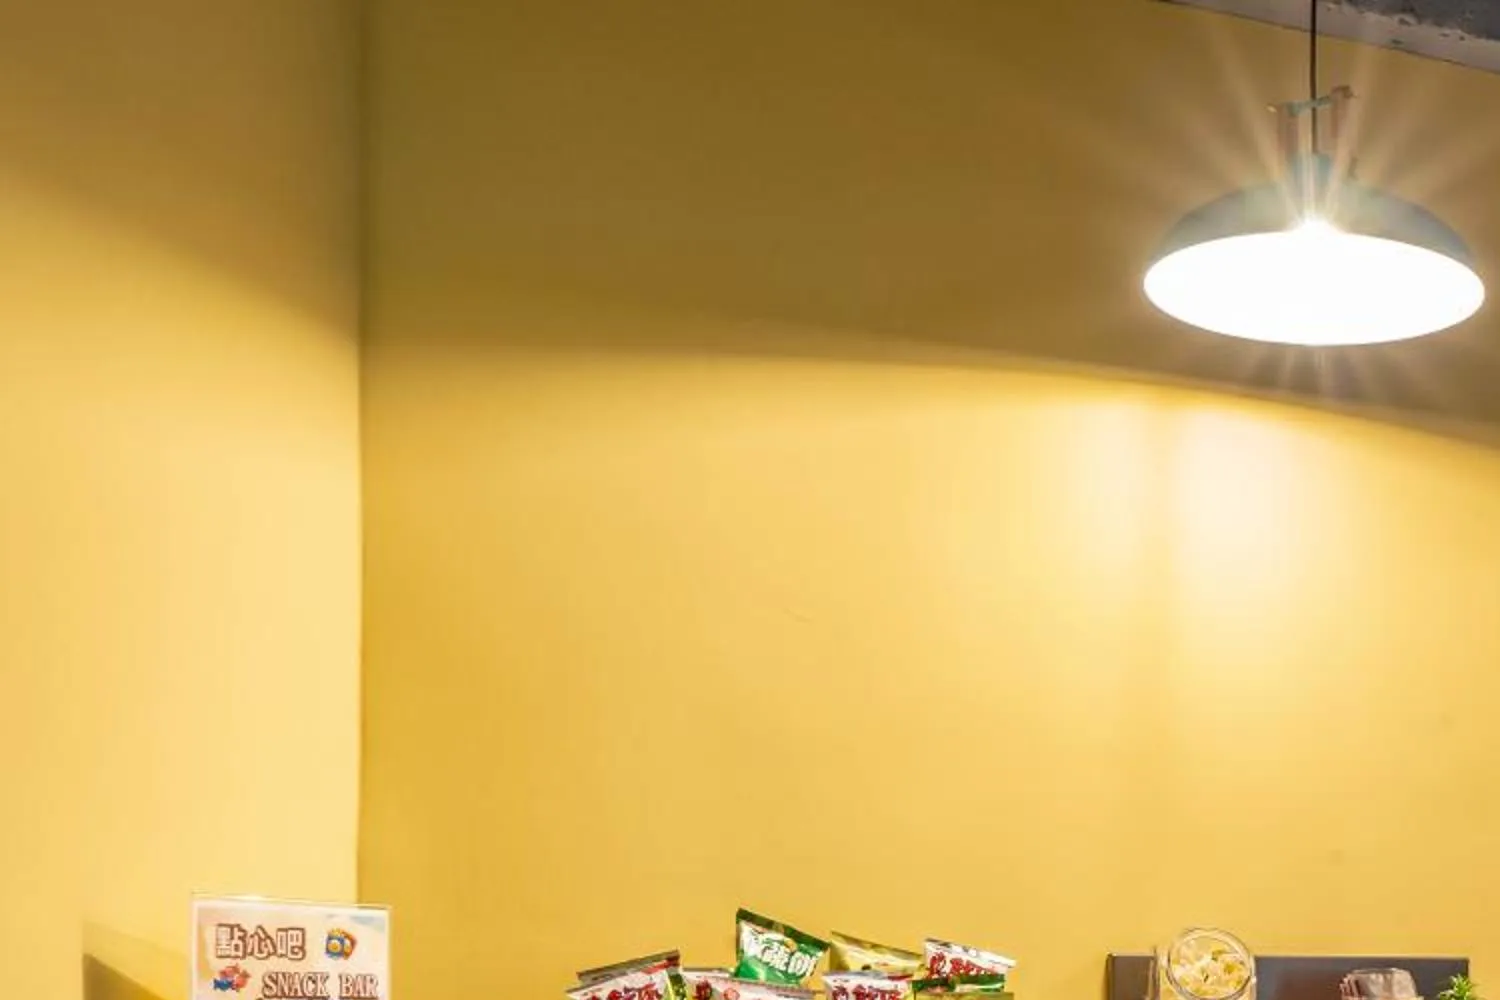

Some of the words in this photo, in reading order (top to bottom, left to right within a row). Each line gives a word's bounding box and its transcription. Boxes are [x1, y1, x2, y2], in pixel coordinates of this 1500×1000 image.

[216, 923, 306, 960] 點心吧
[262, 971, 331, 999] SNACK
[339, 973, 379, 1000] BAR
